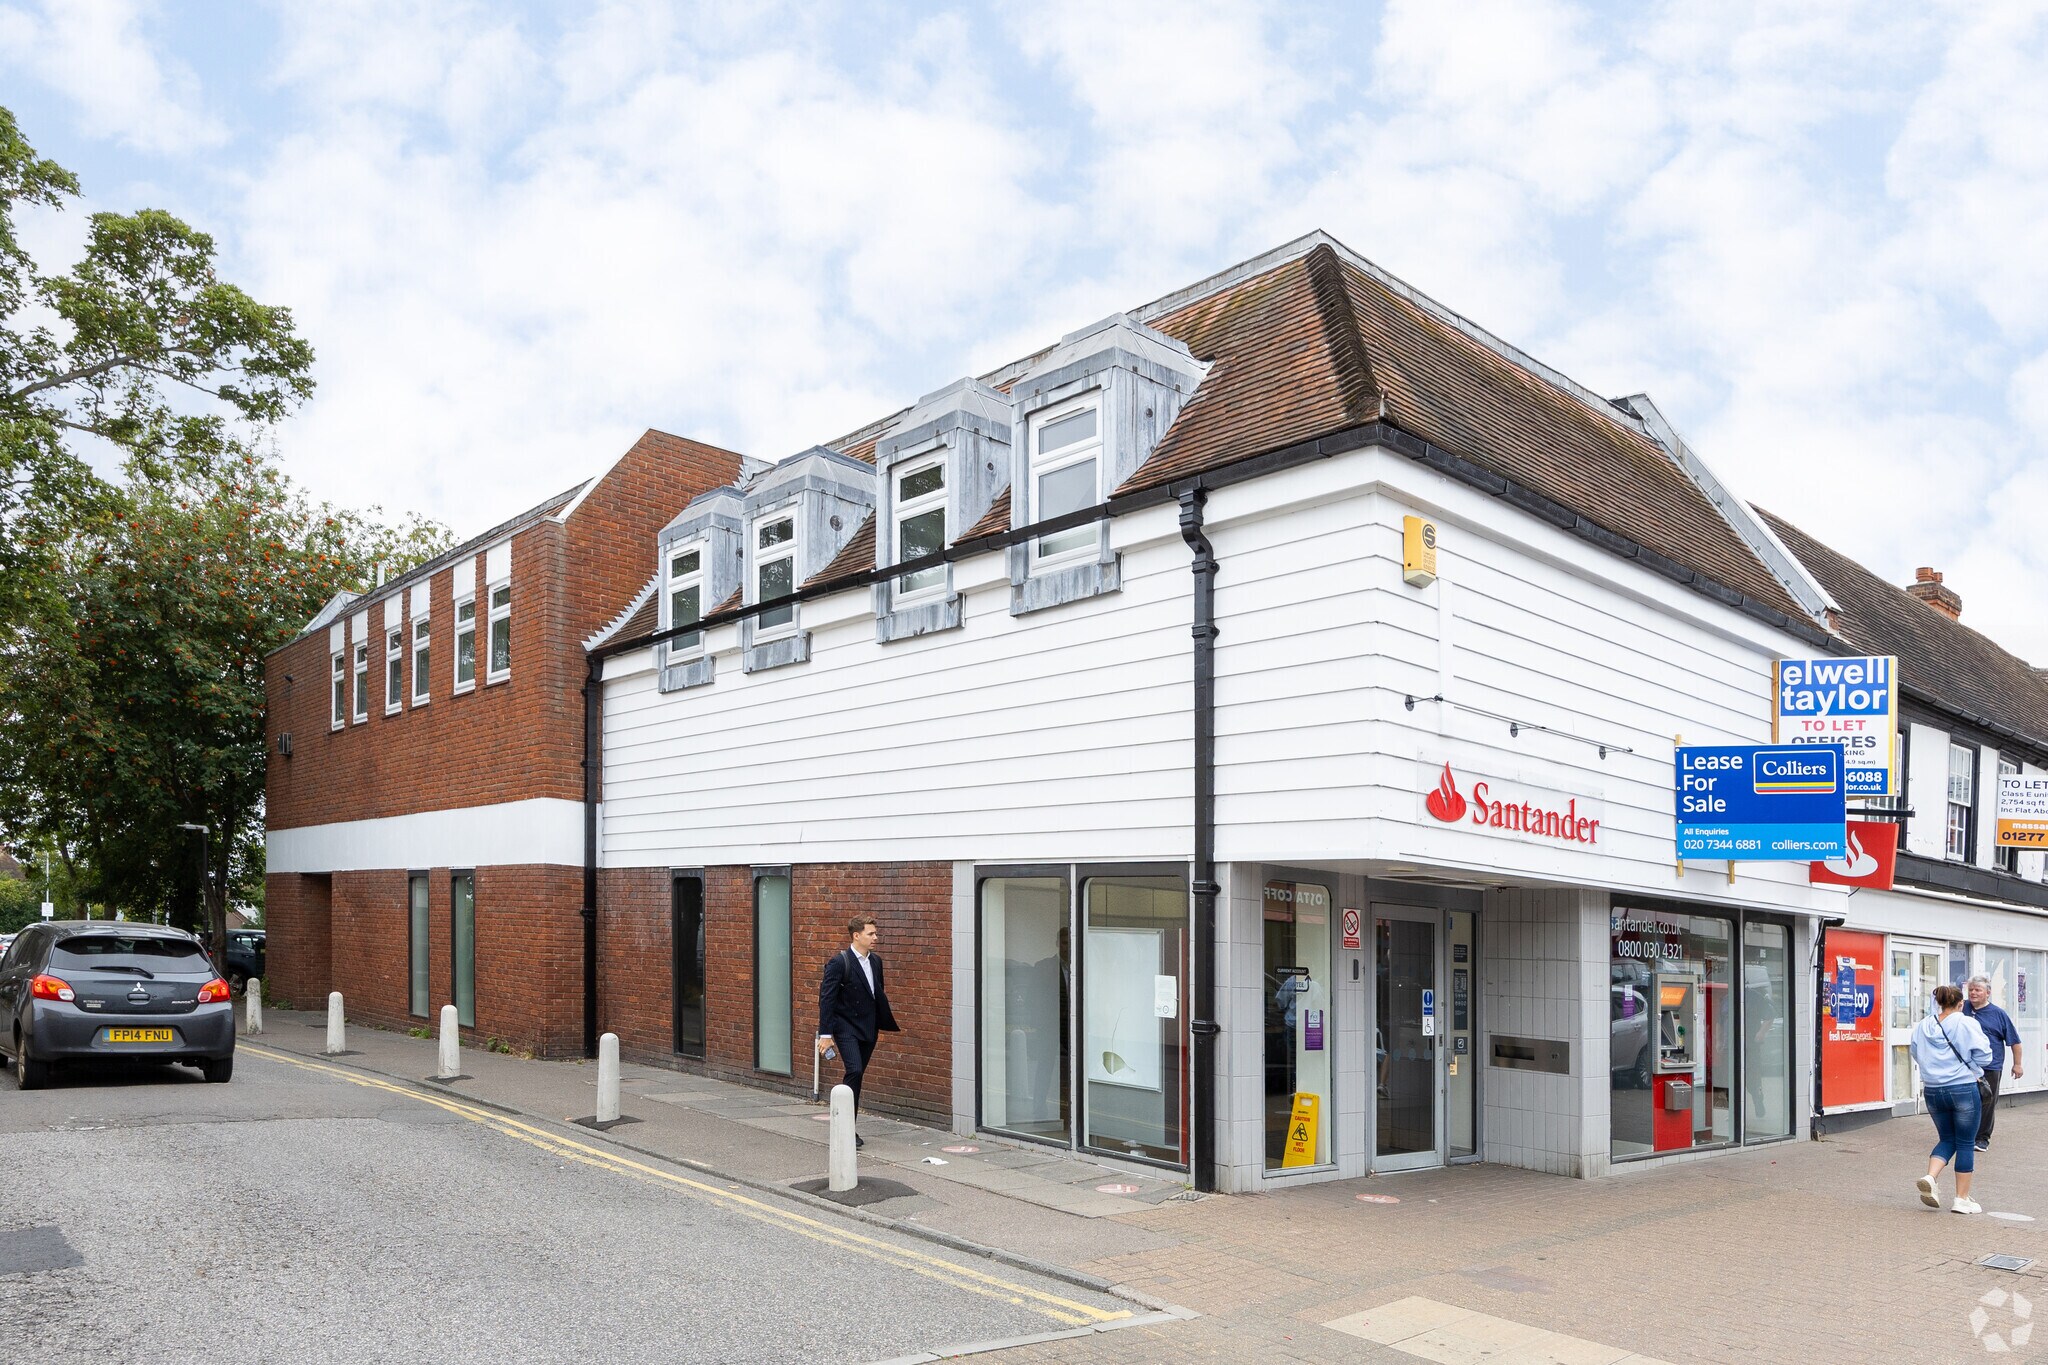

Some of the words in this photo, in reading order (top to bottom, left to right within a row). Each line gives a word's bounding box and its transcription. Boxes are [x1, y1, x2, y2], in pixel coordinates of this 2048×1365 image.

[1783, 659, 1885, 685] elwell
[1782, 684, 1887, 716] taylor
[1802, 721, 1825, 731] TO
[1832, 720, 1866, 731] LET
[1683, 753, 1743, 770] Lease
[1762, 760, 1827, 776] Colliers
[1683, 775, 1717, 791] For
[1845, 771, 1883, 783] 6088
[2002, 780, 2021, 789] TO
[2025, 781, 2048, 790] LET
[1683, 796, 1727, 813] Sale
[1472, 782, 1600, 844] Santander
[1695, 828, 1729, 837] Enquiries
[2002, 832, 2045, 841] 01277
[1684, 840, 1704, 850] 020
[1707, 840, 1733, 850] 7344
[1735, 839, 1761, 850] 6881
[1771, 839, 1838, 850] colliers.com
[1618, 940, 1642, 958] 0800
[1643, 941, 1660, 959] 030
[1662, 943, 1683, 960] 4321
[113, 1030, 142, 1040] FP14
[145, 1030, 169, 1040] FNU
